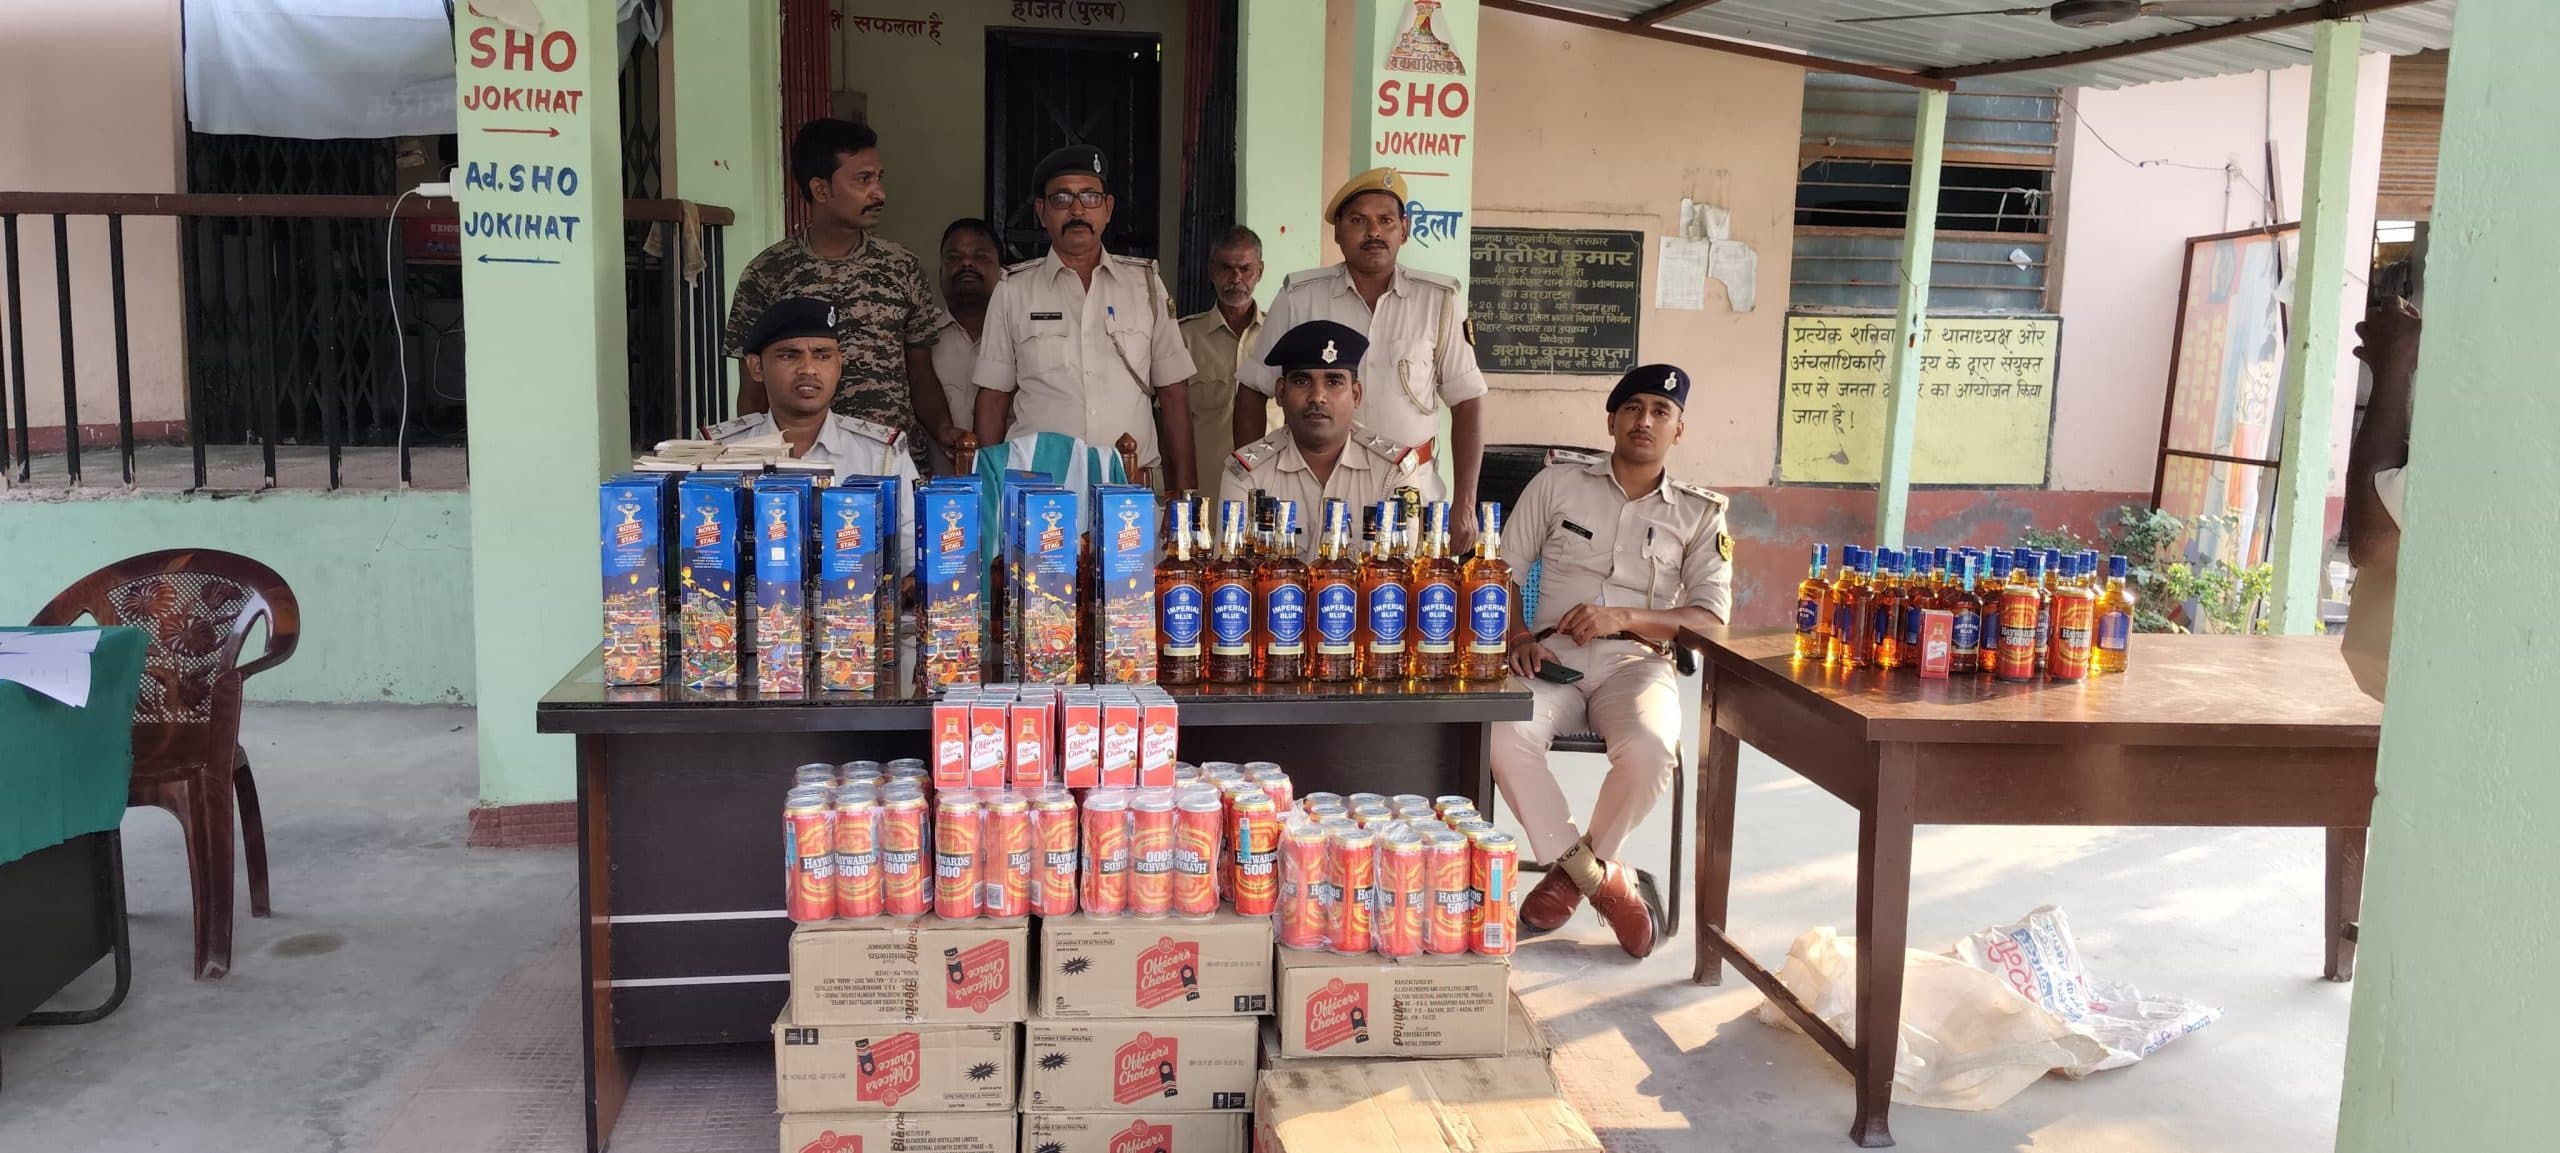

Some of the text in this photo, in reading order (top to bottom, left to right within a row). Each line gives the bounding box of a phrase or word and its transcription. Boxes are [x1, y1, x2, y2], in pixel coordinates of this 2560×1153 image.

[853, 15, 926, 38] सफलता
[927, 11, 944, 45] है
[469, 27, 577, 72] SHO
[464, 85, 583, 116] JOKIHAT
[1377, 80, 1469, 118] SHO
[1376, 131, 1466, 157] JOKIHAT
[464, 212, 580, 243] JOKIHAT
[1405, 201, 1463, 248] हिला
[1574, 237, 1608, 246] सरकार
[1472, 243, 1634, 268] नीतीश कुमार
[1794, 321, 2046, 350] प्रत्येक शनिवा थानाध्यक्ष और
[1492, 342, 1632, 360] अशोक कुमार गुप्ता
[1791, 349, 1886, 371] अंचलाधिकारी
[1946, 349, 1961, 370] के
[2001, 351, 2043, 376] संयुक्त
[1816, 377, 1830, 398] से
[1837, 382, 1876, 398] जनता
[1930, 383, 1950, 398] का
[1955, 377, 2011, 399] आयोजन
[1792, 408, 1828, 427] जाता
[620, 534, 639, 544] STAG
[699, 537, 717, 545] STAG
[1167, 605, 1200, 616] IMPERIAL
[1215, 605, 1248, 615] IMPERIAL
[1222, 611, 1240, 619] BLUE
[1271, 605, 1304, 614] IMPERIAL
[1279, 611, 1297, 619] BLUE
[1321, 604, 1353, 614] IMPERIAL
[1328, 611, 1346, 619] BLUE
[1373, 603, 1405, 613] IMPERIAL
[1381, 610, 1398, 618] BLUE
[1421, 603, 1454, 613] IMPERIAL
[1429, 610, 1446, 618] BLUE
[1474, 603, 1506, 613] IMPERIAL
[840, 865, 868, 877] 5000
[1243, 862, 1273, 875] 5000
[967, 958, 1004, 978] Choice
[1143, 948, 1190, 974] Officer's
[1141, 970, 1179, 990] Choice
[1312, 990, 1360, 1017] Officer's
[1310, 1012, 1348, 1033] Choice
[877, 1050, 915, 1071] Choice
[1122, 1044, 1168, 1070] Officer's
[1119, 1066, 1156, 1086] Choice
